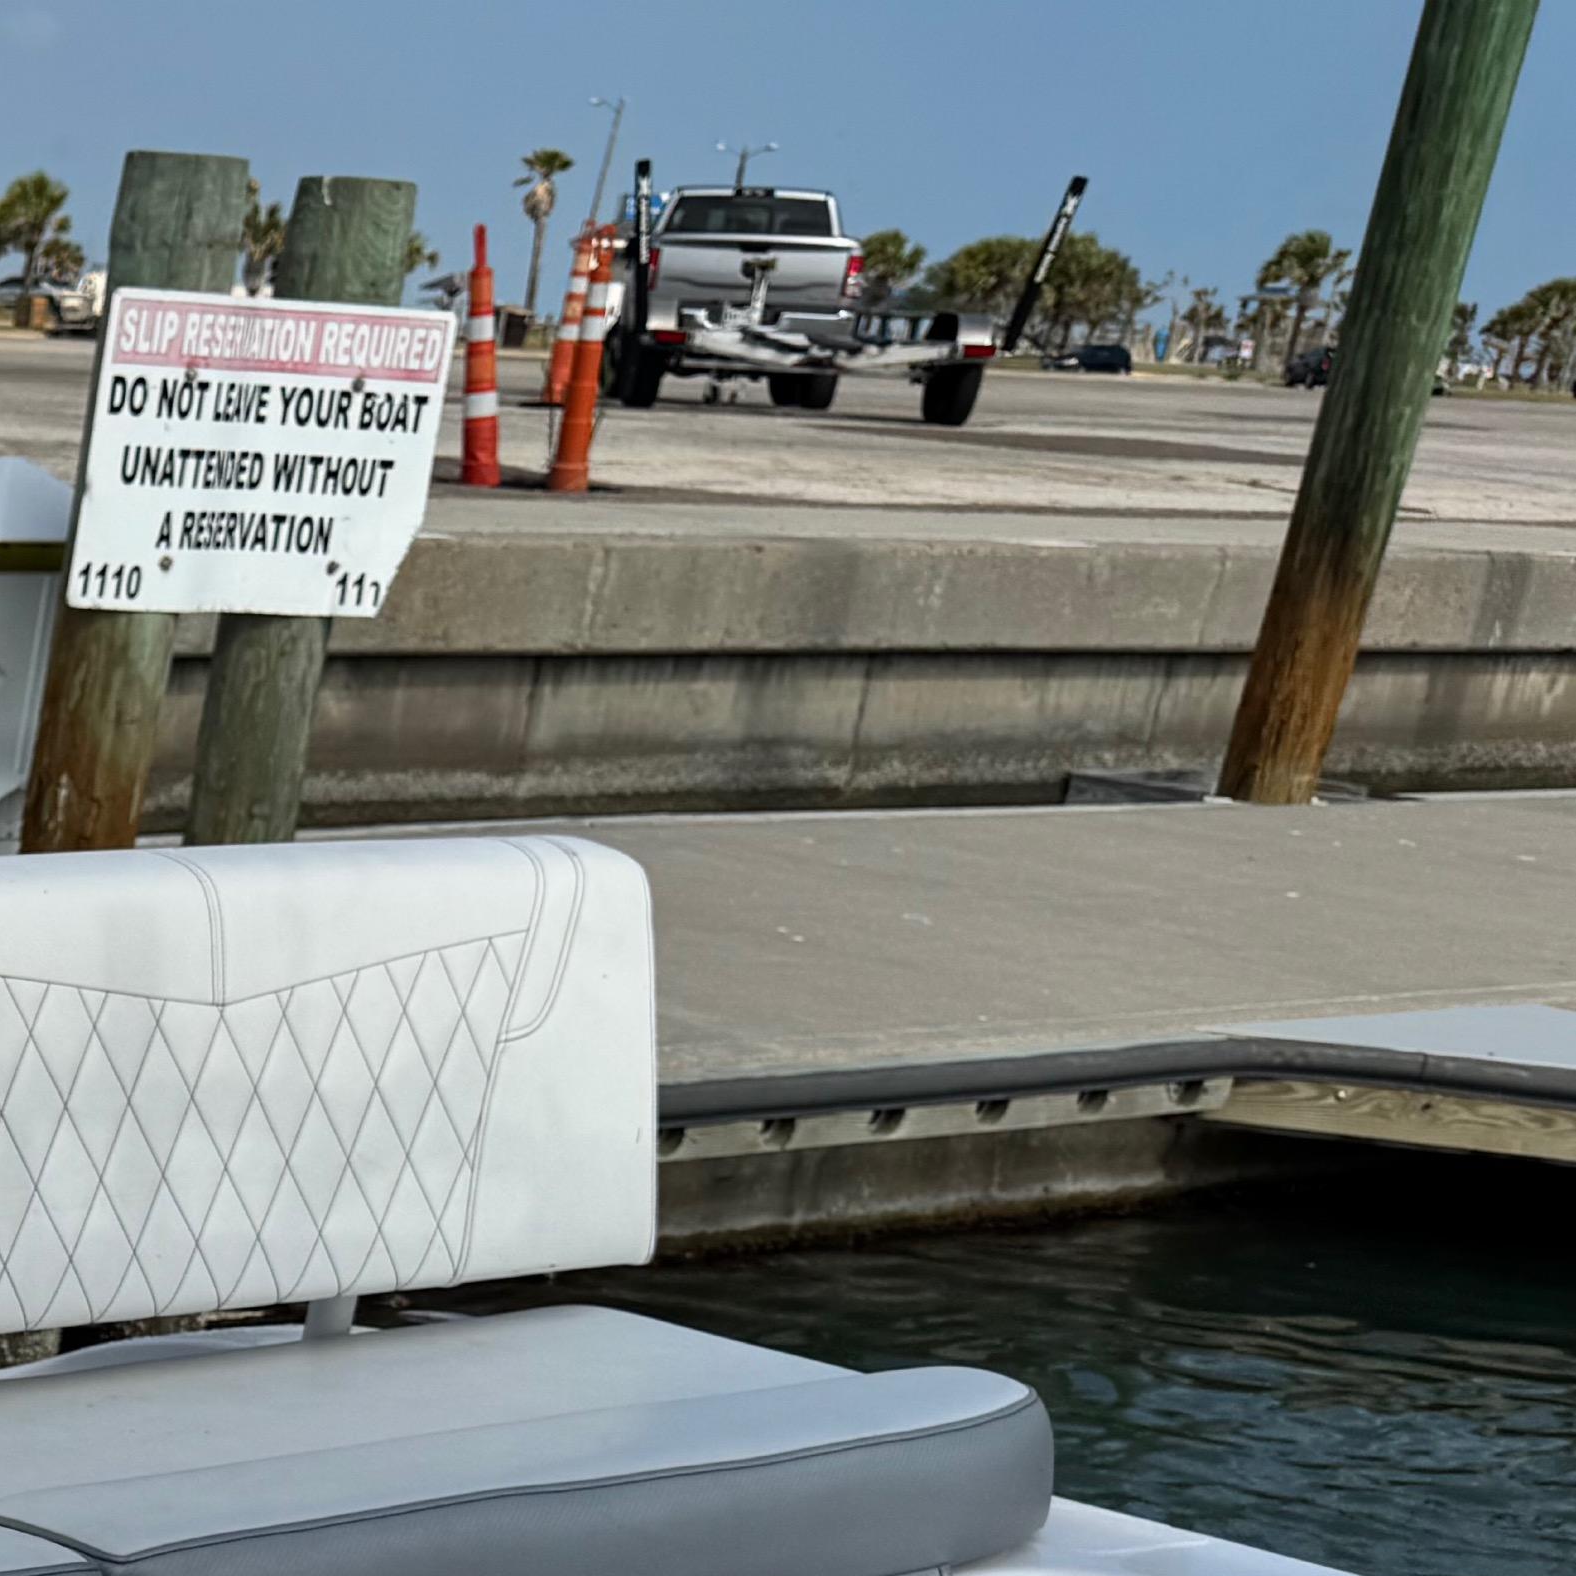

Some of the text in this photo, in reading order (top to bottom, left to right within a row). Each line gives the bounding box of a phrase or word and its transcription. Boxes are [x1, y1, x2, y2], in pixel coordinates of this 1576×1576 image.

[119, 308, 444, 371] SLIP RESERVATION REQUIRED
[108, 376, 429, 433] DO NOT LEAVE YOUR BOAT
[120, 445, 395, 498] UNATTENDED WITHOUT
[155, 511, 333, 554] A RESERVATION
[78, 562, 141, 600] 1110
